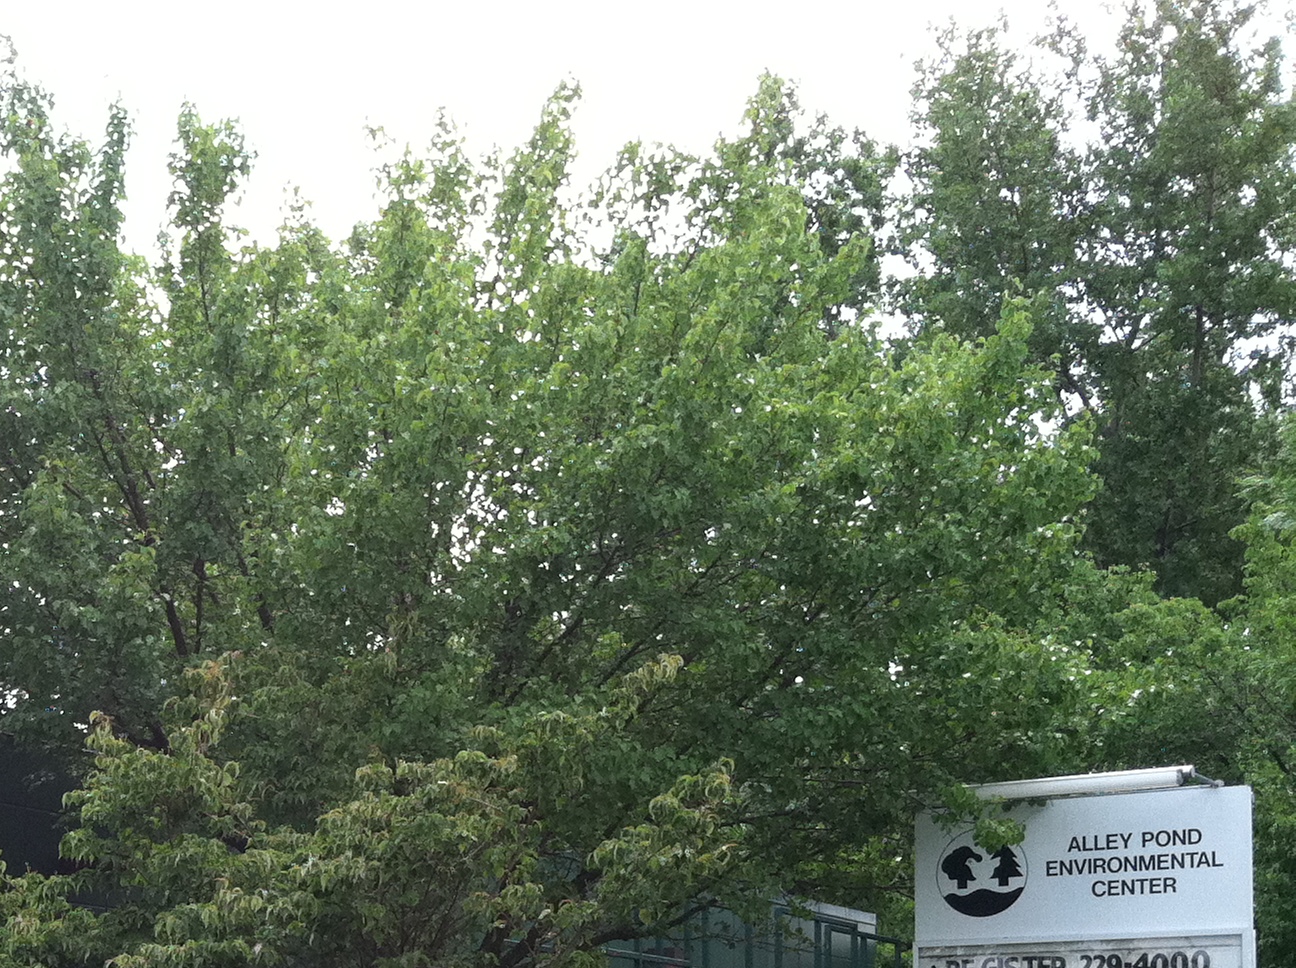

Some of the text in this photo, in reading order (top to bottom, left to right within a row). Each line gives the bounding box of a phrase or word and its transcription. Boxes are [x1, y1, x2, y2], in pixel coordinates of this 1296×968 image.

[1067, 828, 1202, 852] ALLEY POND
[1045, 850, 1224, 877] ENVIRONMENTAL
[1091, 876, 1178, 897] CENTER
